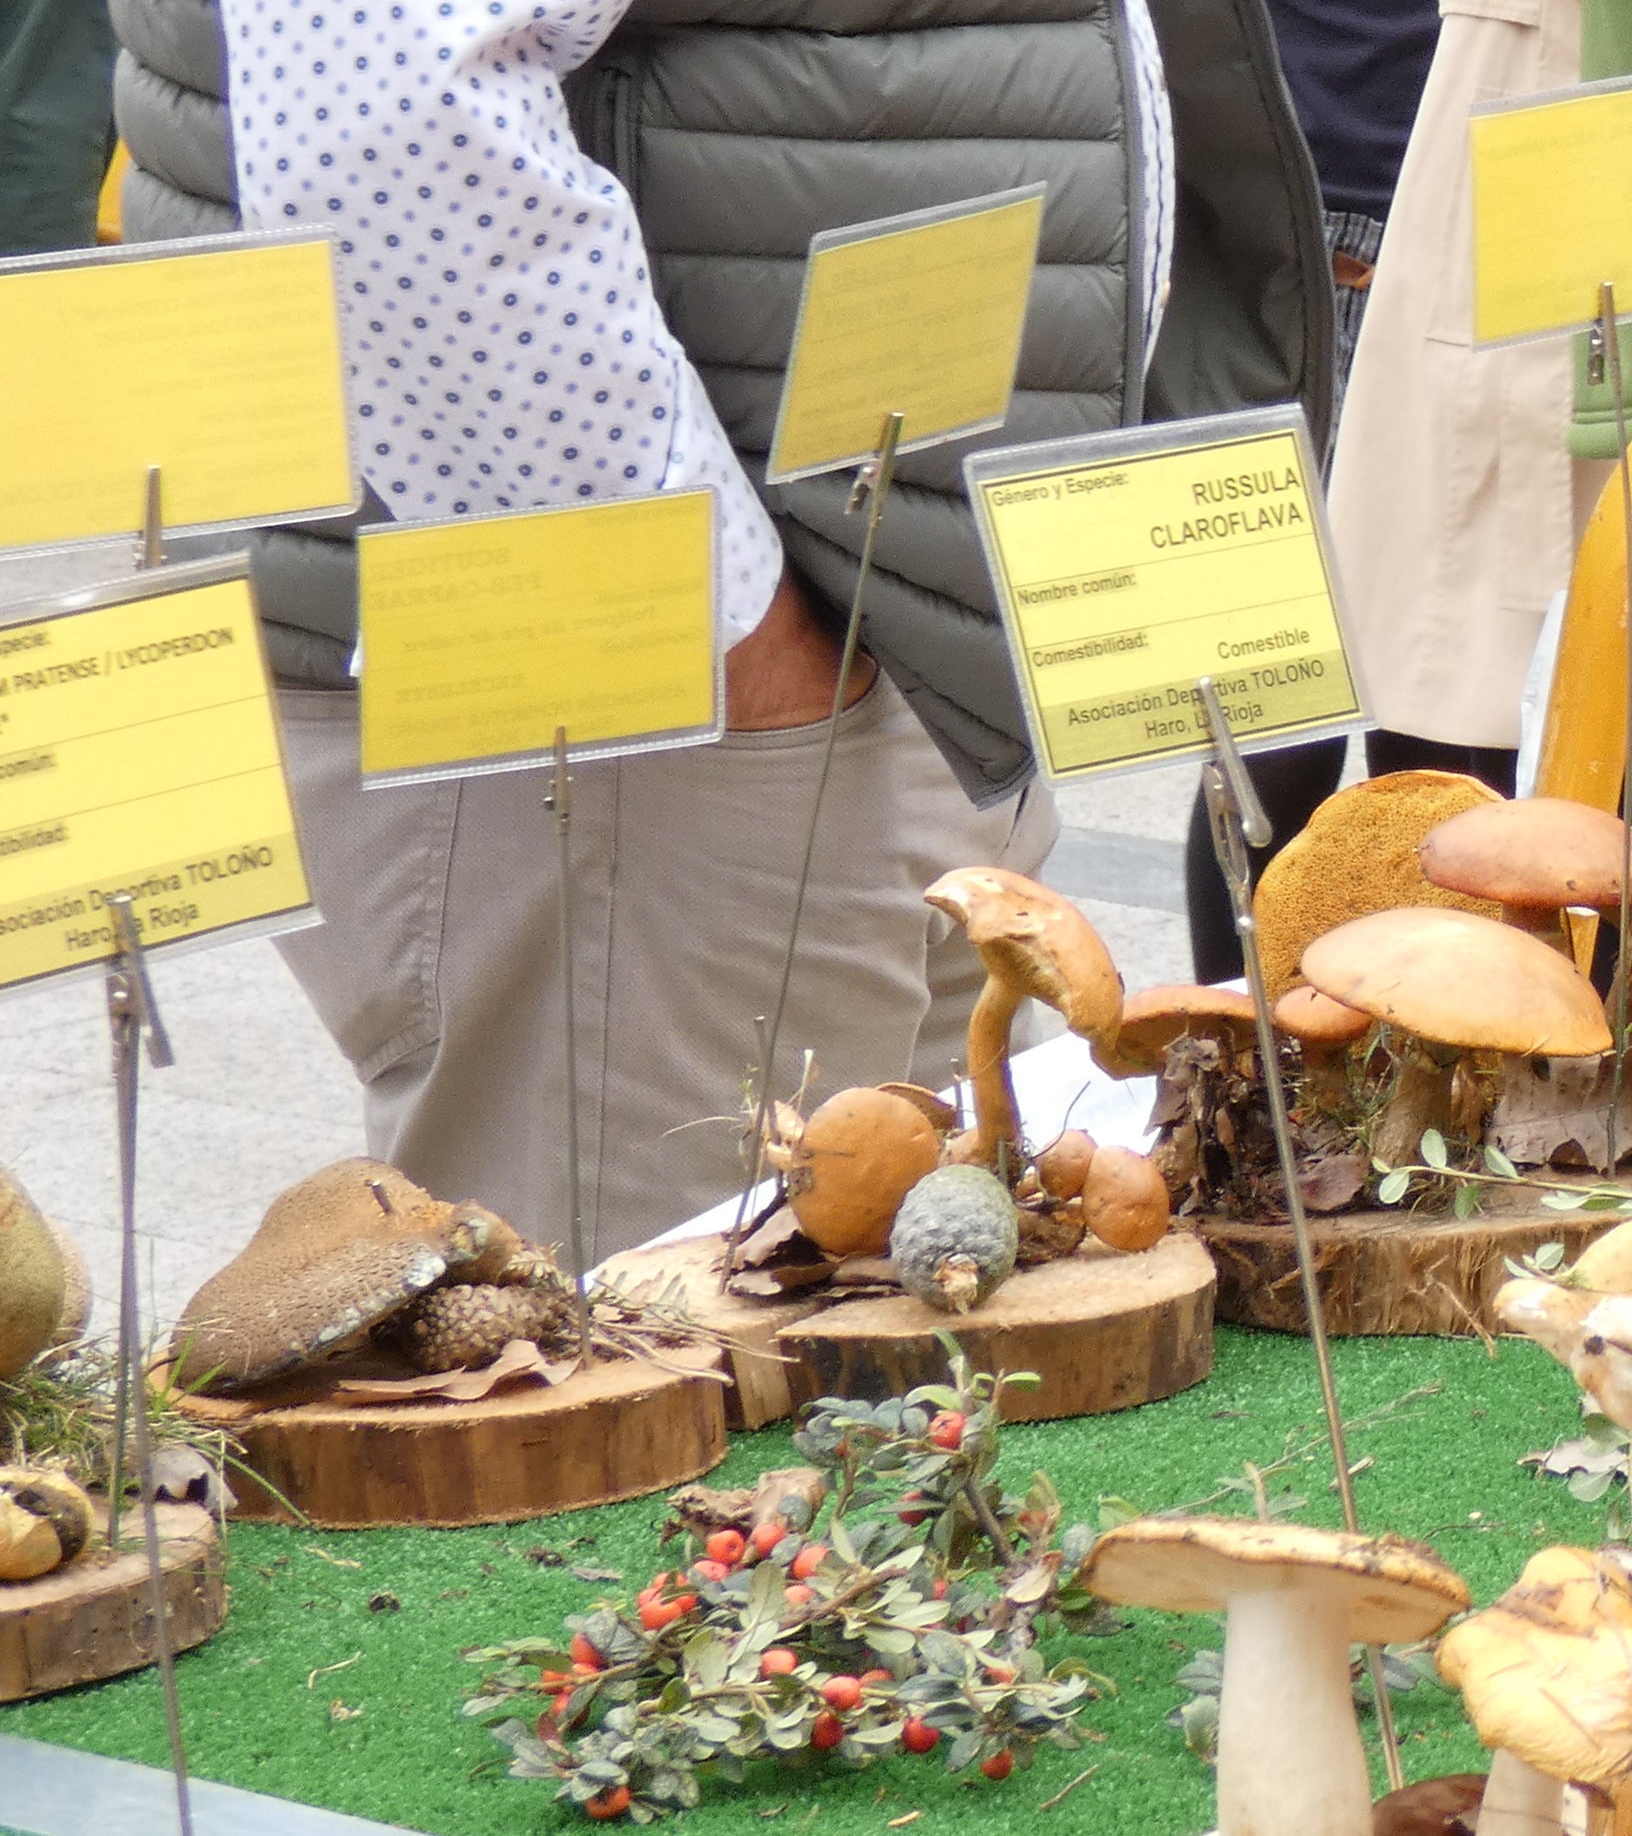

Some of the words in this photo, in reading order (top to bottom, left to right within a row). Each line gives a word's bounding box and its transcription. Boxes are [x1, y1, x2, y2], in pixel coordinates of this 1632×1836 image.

[991, 483, 1050, 508] Género
[1050, 484, 1062, 501] y
[1066, 471, 1129, 496] Especie:
[1192, 466, 1299, 506] RUSSULA
[1150, 502, 1303, 549] CLAROFLAVA
[1017, 583, 1079, 606] Nombre
[1082, 572, 1138, 595] común:
[13, 656, 101, 695] PRATENSE
[117, 626, 235, 671] LYCOPERDON
[1032, 630, 1149, 669] Comestibilidad:
[1217, 628, 1310, 660] Comestible
[1068, 693, 1162, 726] Asociación
[1252, 659, 1324, 691] TOLOÑO
[1145, 717, 1191, 740] Haro,
[185, 845, 273, 885] TOLOÑO
[150, 900, 201, 930] Rioja
